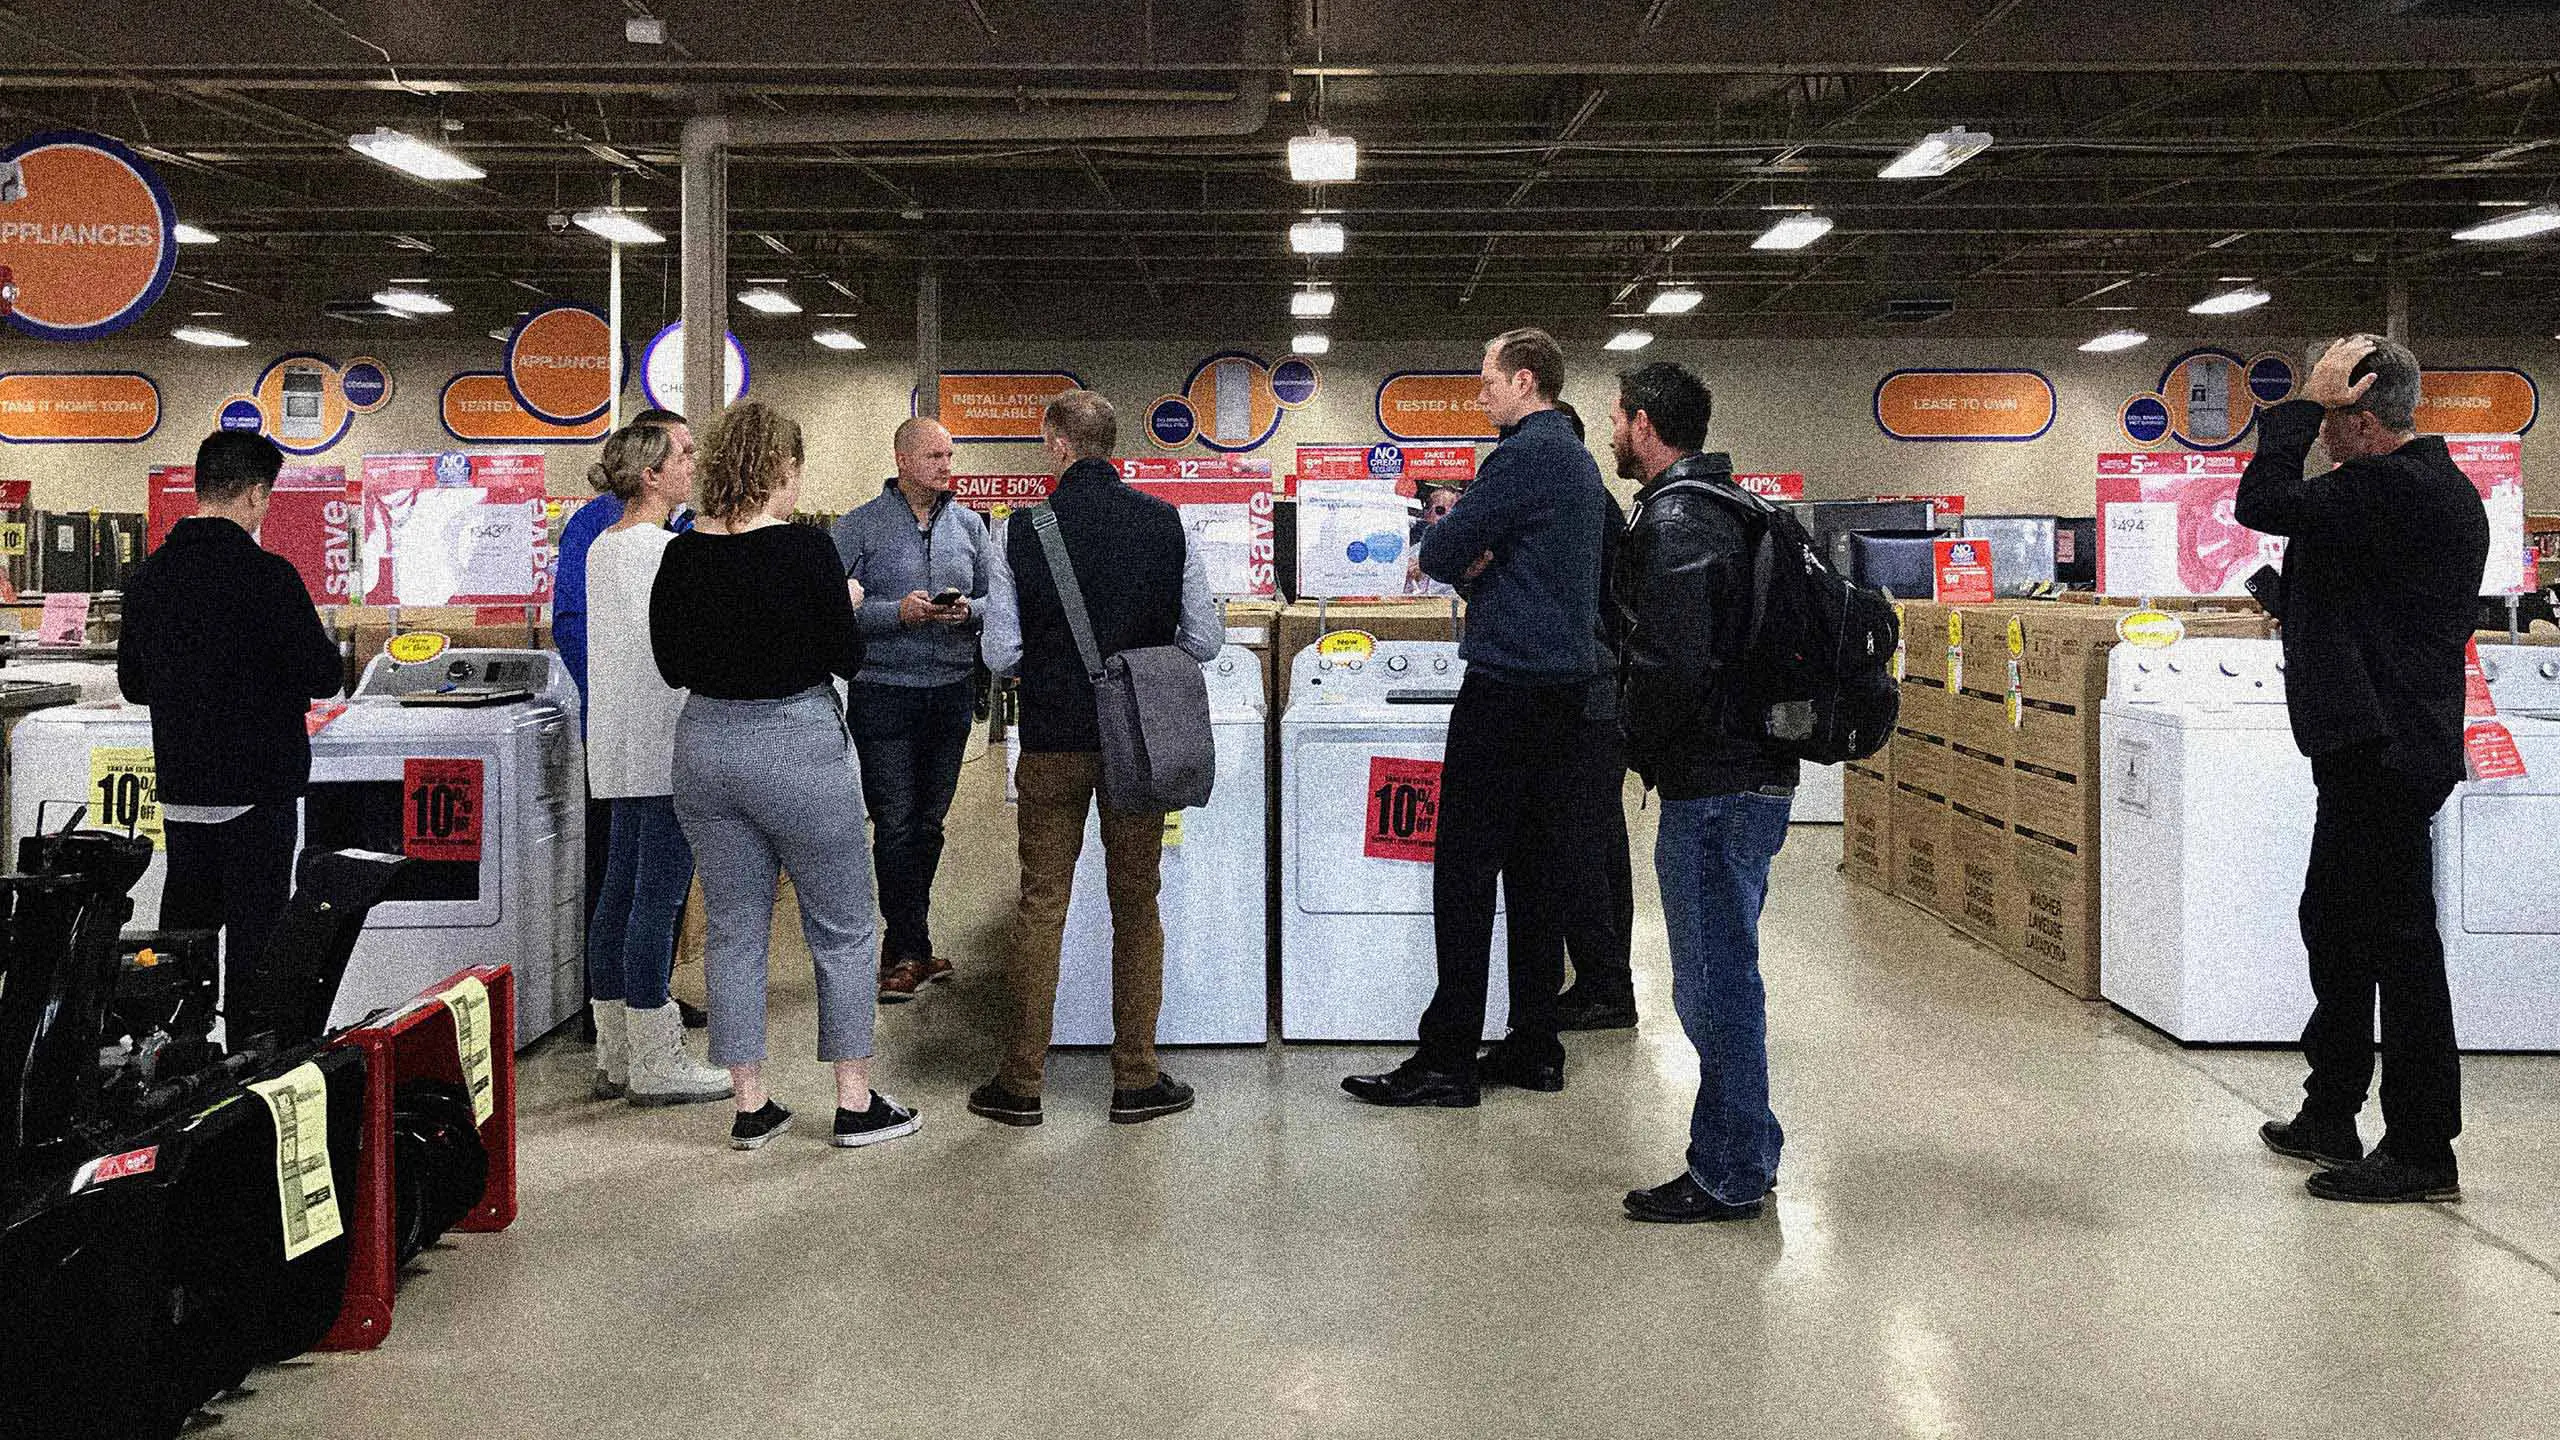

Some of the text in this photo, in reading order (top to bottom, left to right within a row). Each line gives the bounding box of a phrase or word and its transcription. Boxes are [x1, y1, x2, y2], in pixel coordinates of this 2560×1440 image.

[518, 353, 610, 370] APPLIANCE
[460, 400, 512, 413] TESTED
[1396, 400, 1447, 411] TESTED
[1914, 399, 2017, 410] LEASE TO OWN
[2433, 396, 2492, 408] BRANDS
[965, 408, 1037, 419] AVAILABLE
[441, 454, 465, 468] NO
[1375, 447, 1398, 459] NO
[1424, 451, 1455, 459] TAKE IT
[1179, 461, 1199, 478] 12
[1370, 458, 1402, 466] CREDIT
[1410, 459, 1436, 467] HOME
[2184, 455, 2206, 474] 12
[957, 477, 1046, 495] SAVE 50%
[1739, 477, 1781, 493] 40%
[532, 498, 549, 592] save
[1250, 492, 1274, 584] save
[323, 501, 350, 596] save
[98, 773, 157, 825] 10%
[140, 805, 155, 820] OFF
[412, 784, 473, 838] 10%
[1375, 783, 1435, 838] 10%
[2030, 891, 2061, 916] WASHER
[2029, 911, 2064, 941] LAVEUSE
